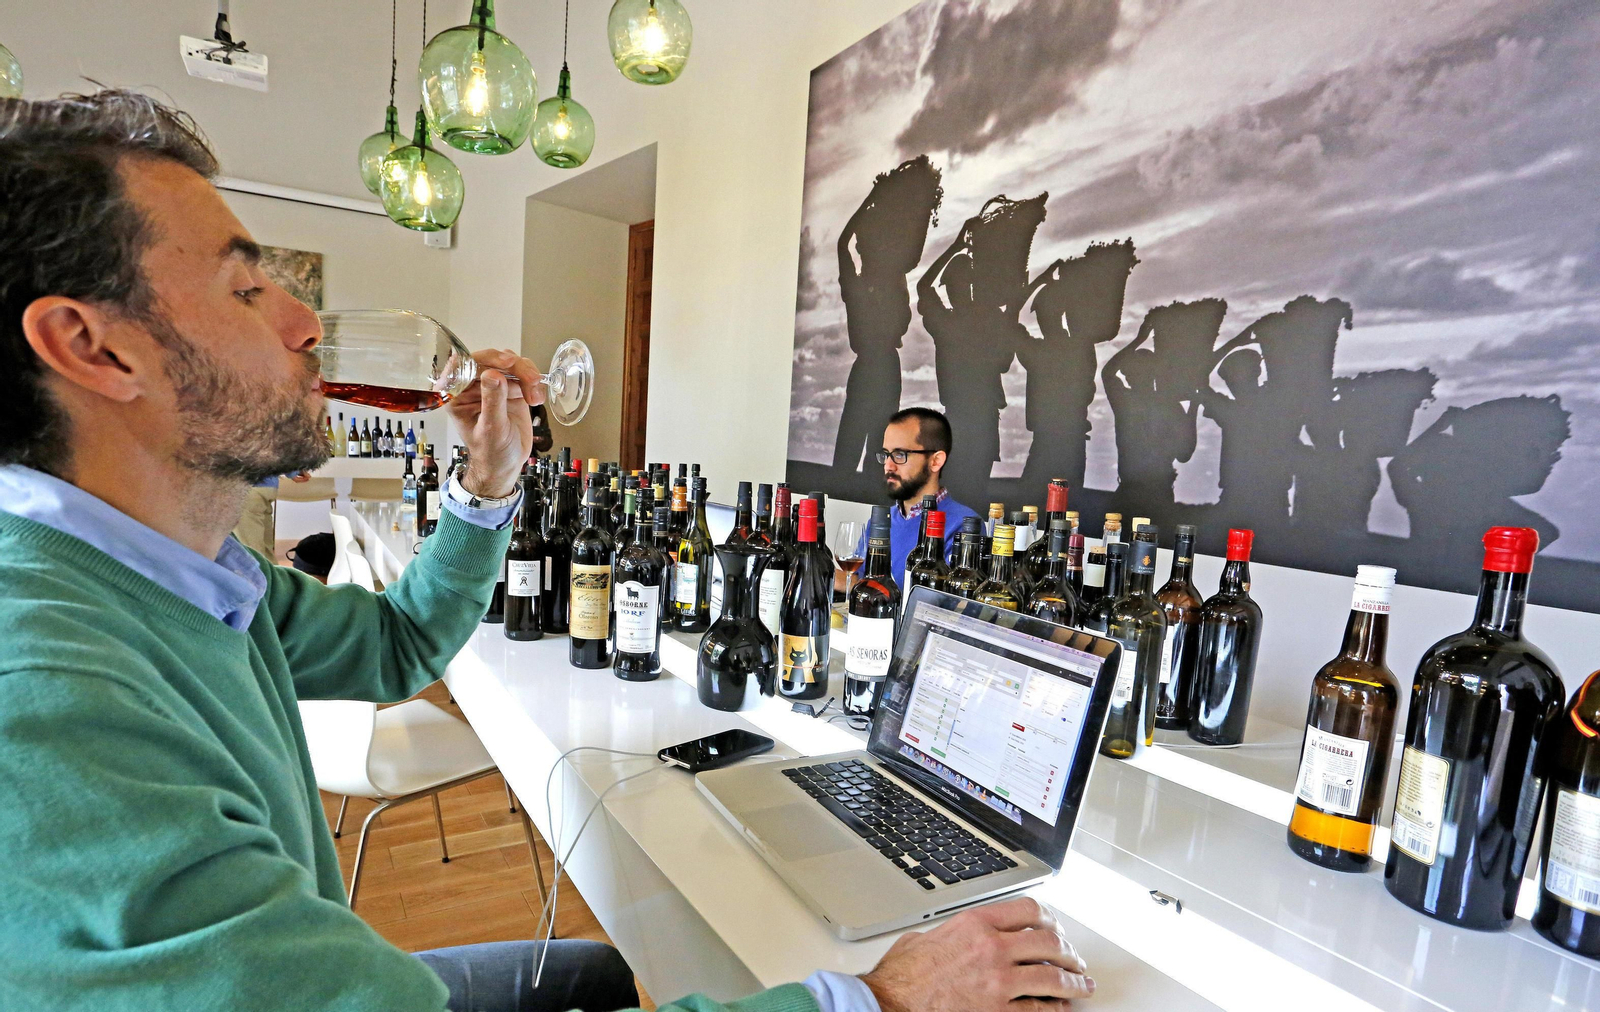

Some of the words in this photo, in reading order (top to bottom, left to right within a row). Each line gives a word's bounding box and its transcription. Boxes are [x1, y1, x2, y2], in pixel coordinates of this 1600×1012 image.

[1362, 603, 1391, 611] CIGARRE
[857, 647, 888, 660] SEÑORAS
[1318, 742, 1354, 757] CIGARRERA
